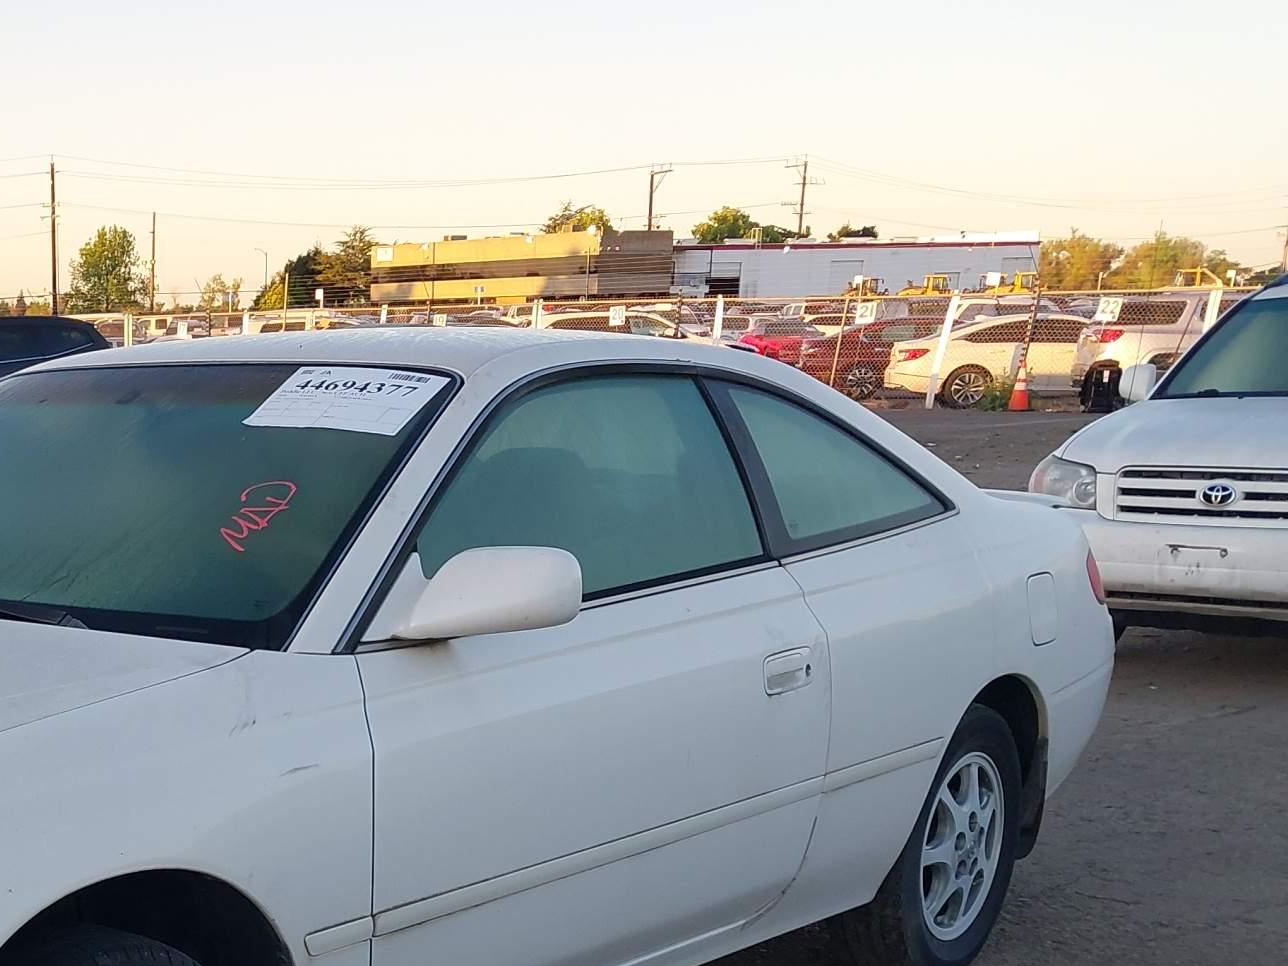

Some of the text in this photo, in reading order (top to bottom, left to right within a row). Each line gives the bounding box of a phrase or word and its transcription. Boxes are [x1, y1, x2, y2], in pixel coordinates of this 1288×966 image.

[612, 307, 624, 320] 20
[859, 304, 875, 318] 21
[1101, 300, 1120, 314] 22
[296, 378, 418, 397] 44694377
